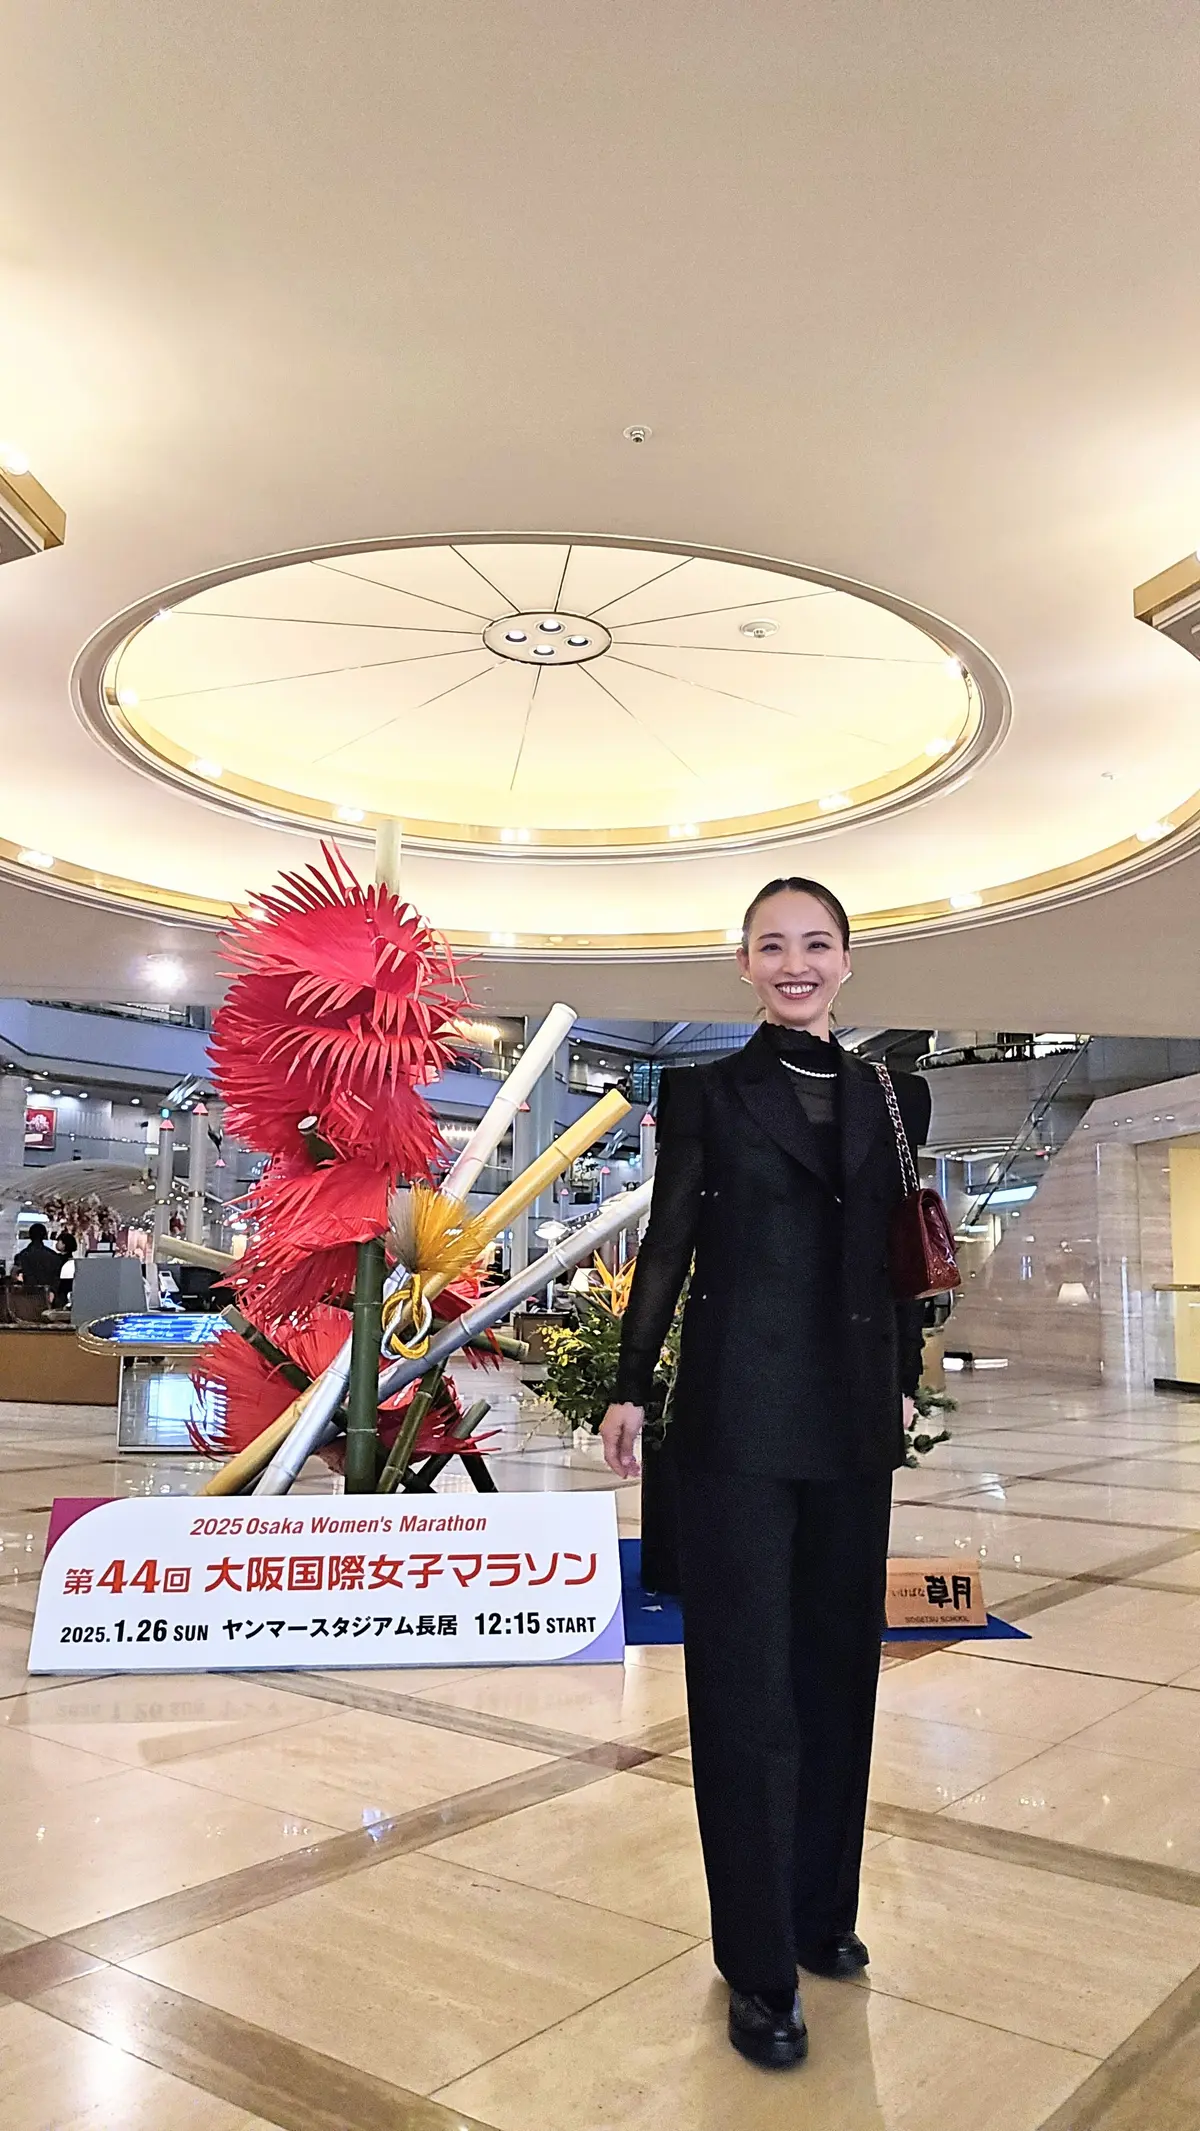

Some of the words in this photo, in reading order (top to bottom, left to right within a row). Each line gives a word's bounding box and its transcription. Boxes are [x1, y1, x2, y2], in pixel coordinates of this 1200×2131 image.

[190, 1518, 243, 1535] 2025
[246, 1517, 303, 1535] Osaka
[311, 1516, 393, 1534] Women's
[399, 1514, 487, 1533] Marathon
[63, 1559, 191, 1594] 第44回
[204, 1552, 597, 1593] 大阪国際女子マラソン
[924, 1575, 971, 1610] 草月
[60, 1619, 167, 1643] 2025.1.26
[172, 1624, 209, 1642] SUN
[222, 1614, 458, 1641] ヤンマースタジアム長居
[475, 1611, 541, 1636] 12:15
[547, 1616, 597, 1634] START
